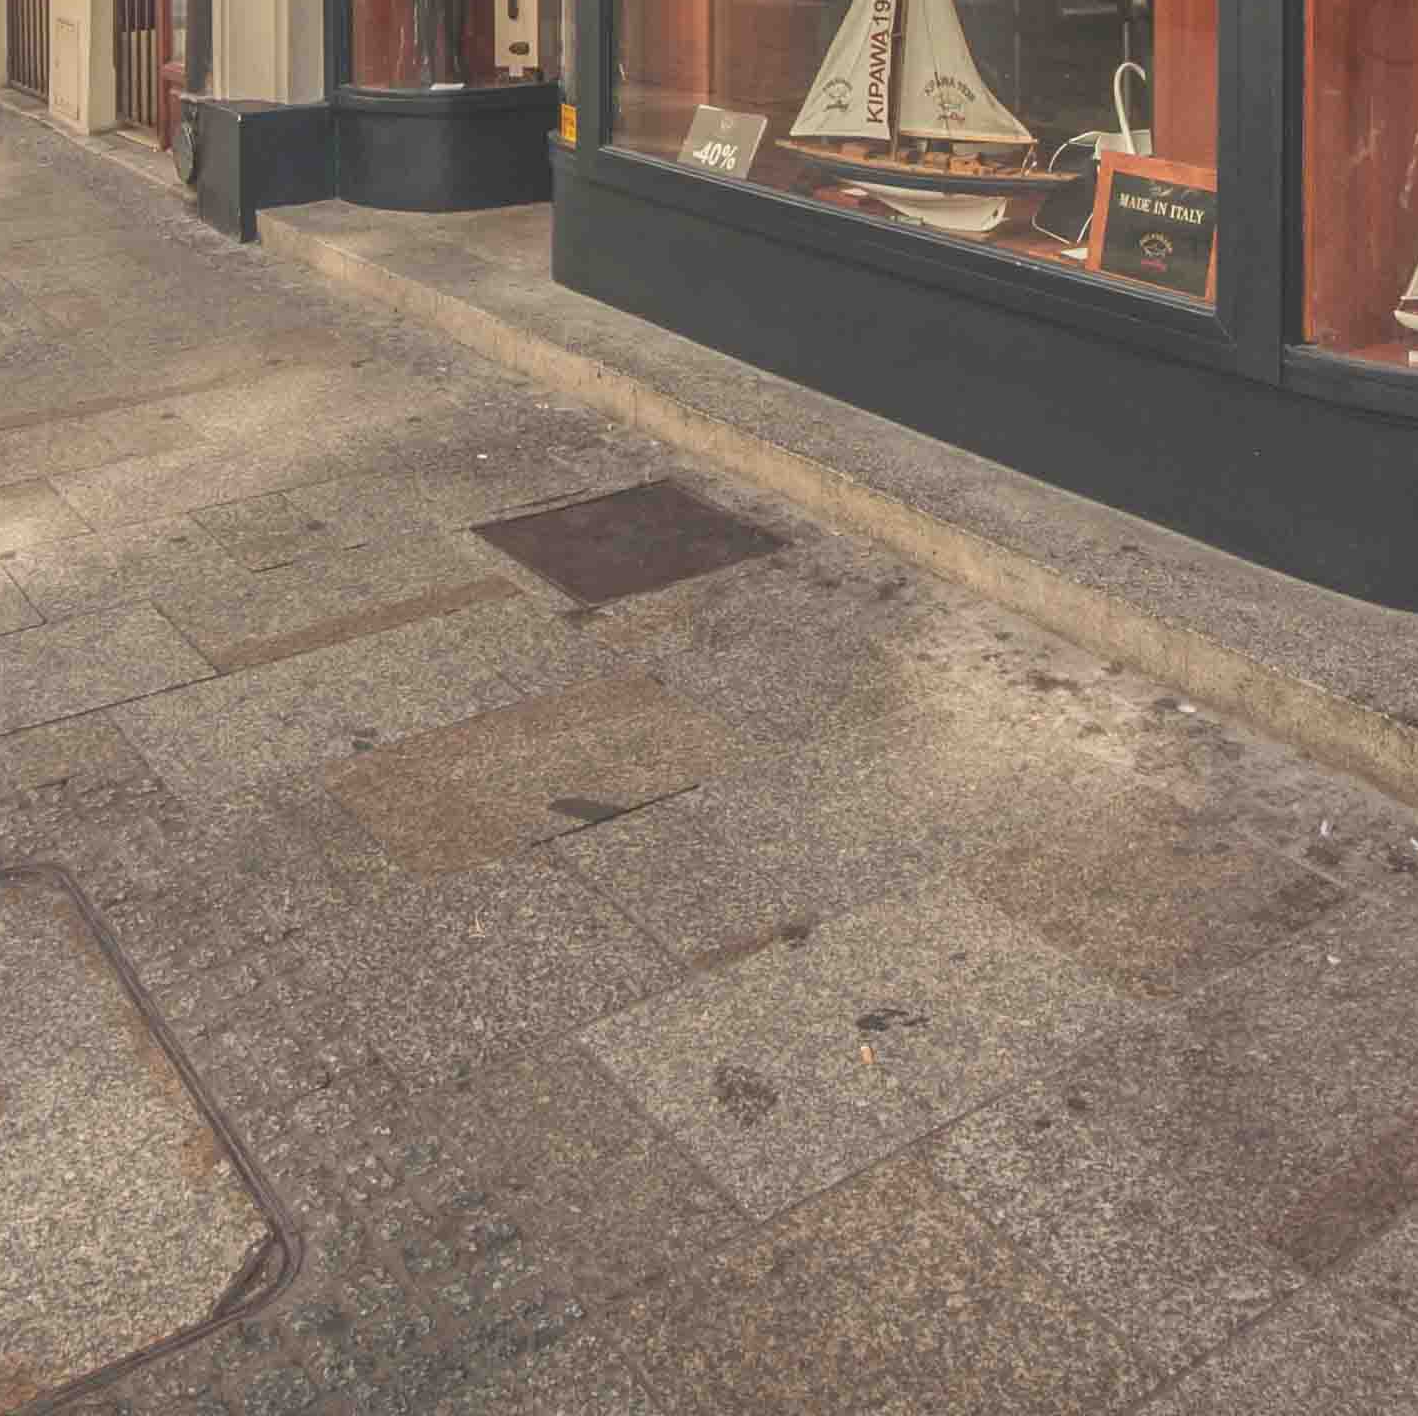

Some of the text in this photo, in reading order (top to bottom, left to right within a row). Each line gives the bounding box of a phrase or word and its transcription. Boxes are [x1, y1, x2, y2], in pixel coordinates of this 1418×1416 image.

[867, 31, 889, 124] KIPAWA
[1119, 192, 1205, 225] MADE IN ITALY
